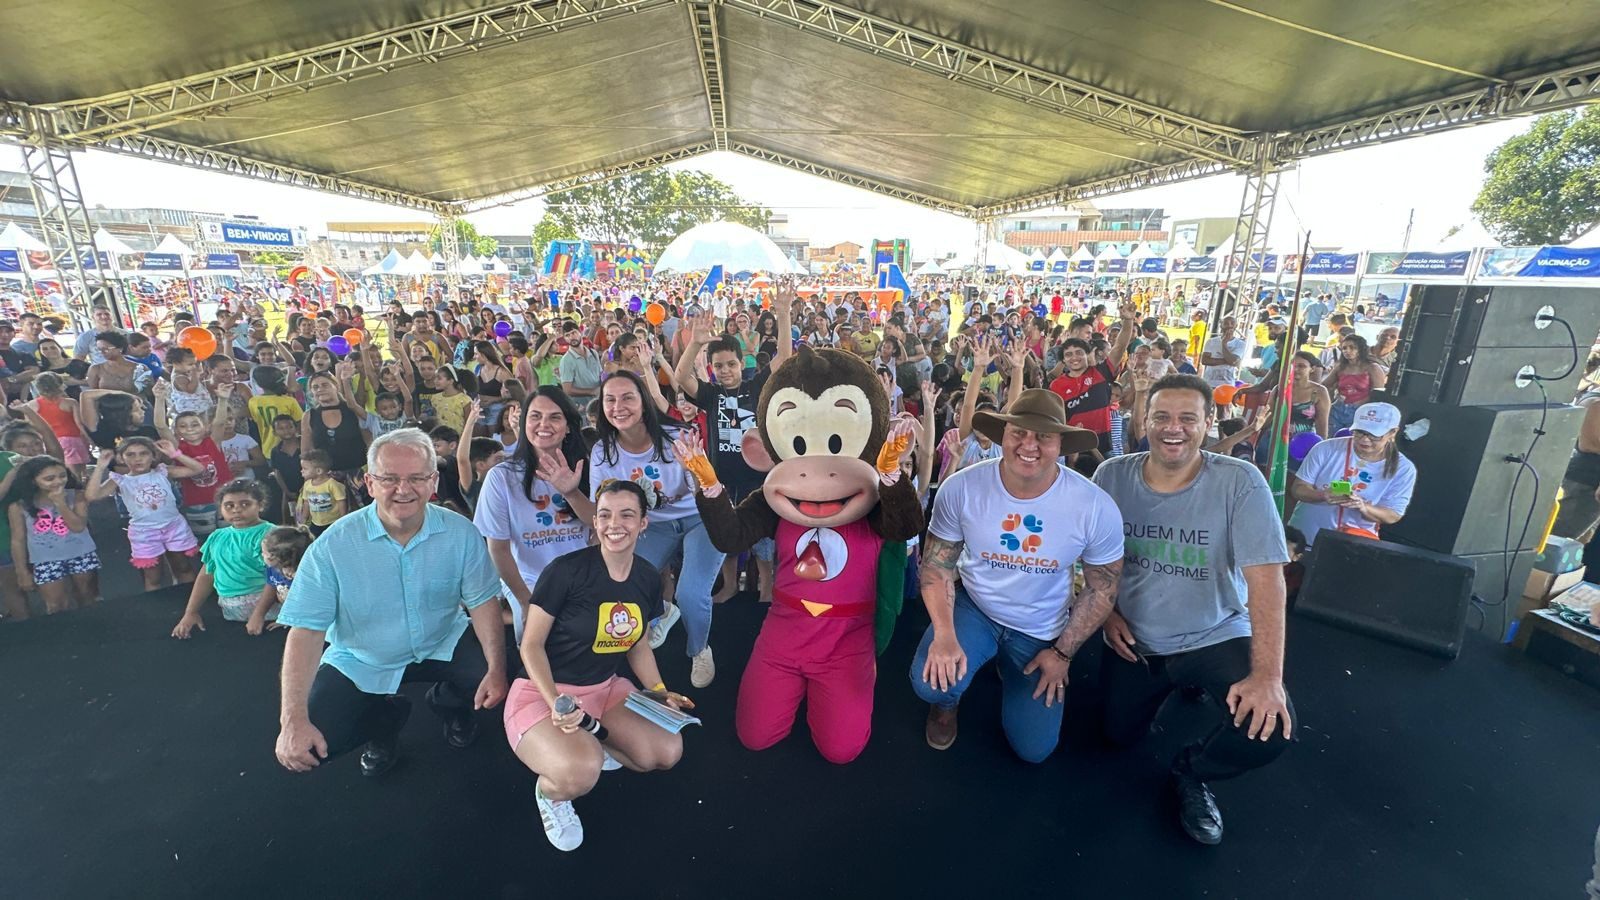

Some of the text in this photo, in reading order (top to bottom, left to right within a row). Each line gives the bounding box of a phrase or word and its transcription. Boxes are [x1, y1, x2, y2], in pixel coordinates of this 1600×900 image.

[226, 227, 290, 242] BEM-VINDOS!
[1537, 258, 1590, 268] VACINAÇÃO
[1123, 521, 1209, 546] QUEM ME
[981, 552, 1059, 567] CARIACICA
[1020, 563, 1032, 574] de
[1153, 561, 1209, 578] DORME
